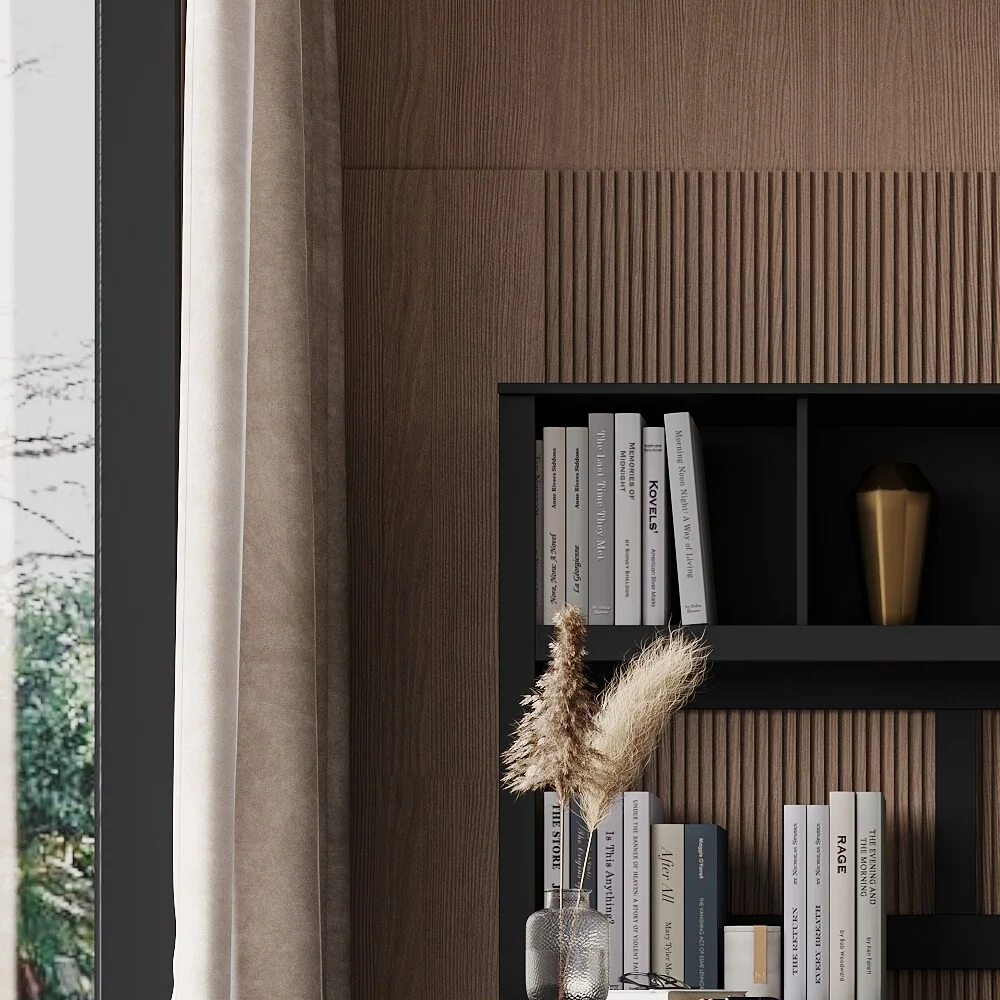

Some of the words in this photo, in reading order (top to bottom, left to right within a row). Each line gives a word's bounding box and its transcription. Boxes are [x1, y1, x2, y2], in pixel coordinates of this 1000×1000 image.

[597, 430, 606, 451] The
[675, 430, 684, 464] Morning
[597, 454, 606, 476] Last
[678, 466, 687, 487] Noon
[597, 480, 606, 507] Time
[680, 489, 690, 514] Night:
[649, 480, 658, 534] KOVELS'
[595, 510, 606, 537] They
[683, 523, 692, 540] Way
[597, 540, 606, 561] Met
[685, 542, 693, 550] of
[686, 552, 694, 579] Living
[573, 583, 580, 594] La
[552, 804, 560, 828] THE
[605, 831, 614, 841] Is
[552, 831, 560, 870] STORE
[605, 844, 615, 868] This
[838, 835, 847, 874] RAGE
[633, 861, 638, 869] OF
[658, 845, 674, 880] After
[604, 870, 615, 924] Anything?
[661, 881, 674, 904] All
[633, 925, 638, 933] OF
[664, 921, 672, 940] Mary
[664, 943, 672, 961] Tyler
